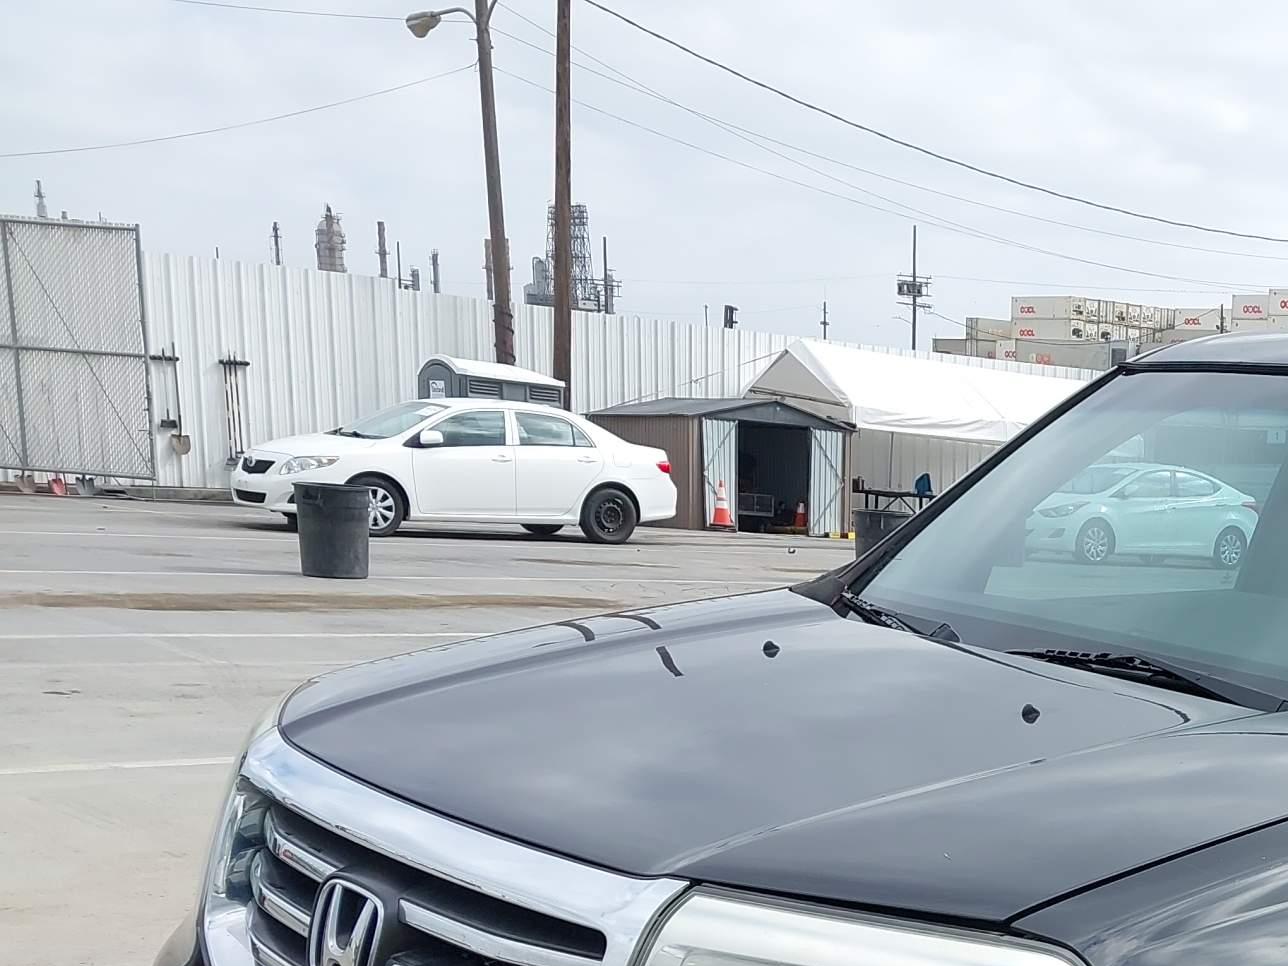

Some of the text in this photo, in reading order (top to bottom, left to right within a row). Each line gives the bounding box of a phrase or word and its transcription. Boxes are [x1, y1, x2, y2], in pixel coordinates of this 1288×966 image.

[1020, 305, 1036, 314] OOCL
[1242, 305, 1262, 314] OOCL
[1184, 317, 1201, 326] OOCL
[1019, 328, 1035, 337] OOCL
